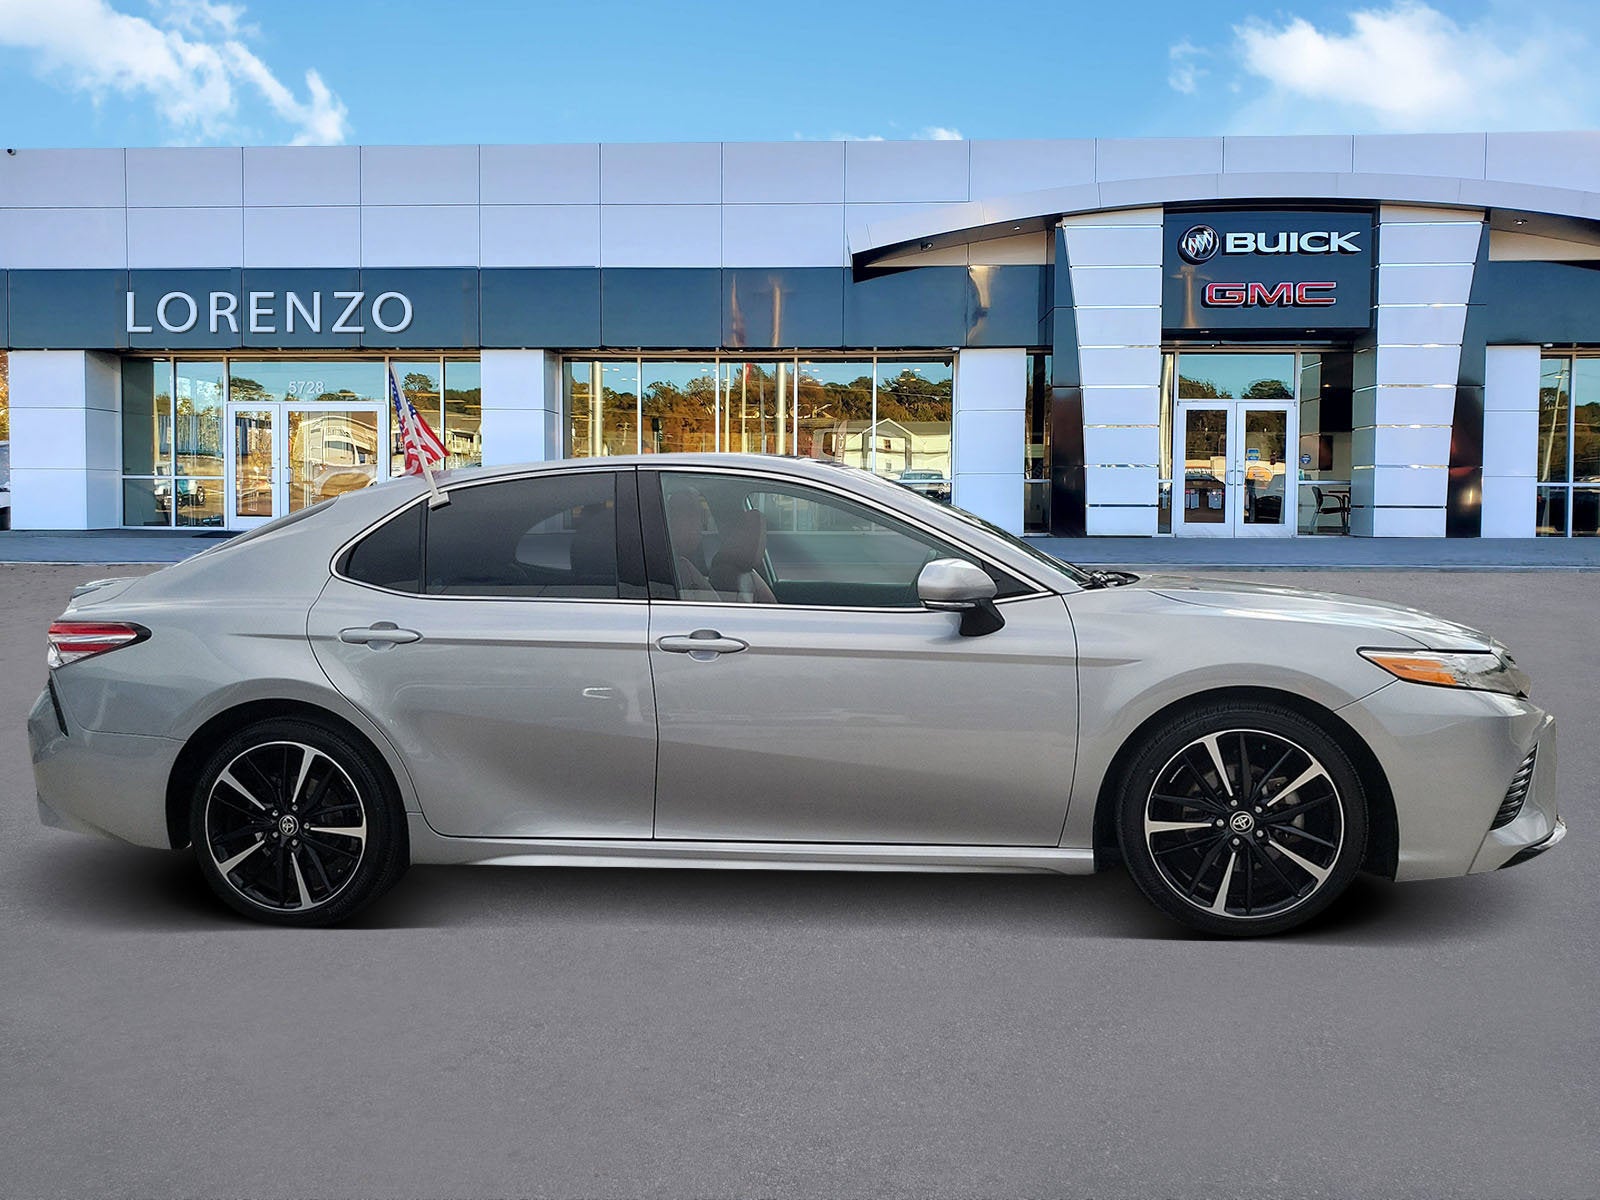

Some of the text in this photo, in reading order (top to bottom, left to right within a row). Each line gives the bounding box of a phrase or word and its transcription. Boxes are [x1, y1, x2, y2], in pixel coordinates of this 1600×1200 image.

[1225, 231, 1362, 253] BUICK
[1205, 281, 1337, 306] GMC
[126, 291, 414, 334] LORENZO
[289, 381, 324, 394] 5728
